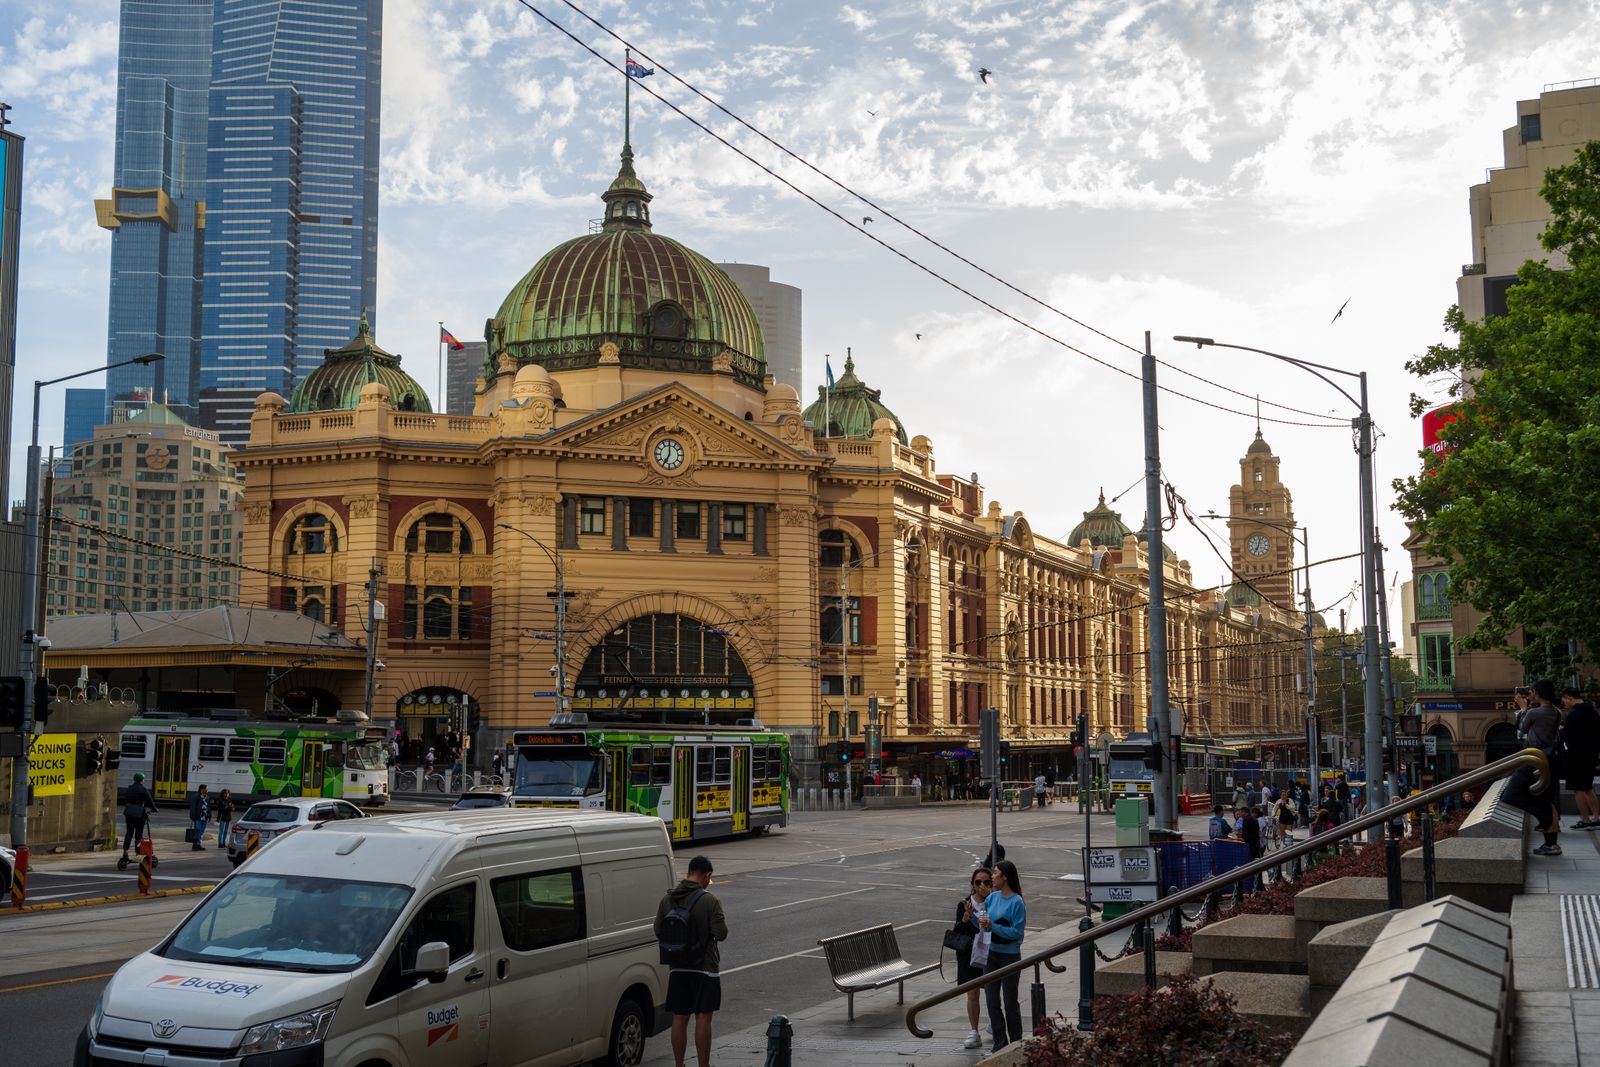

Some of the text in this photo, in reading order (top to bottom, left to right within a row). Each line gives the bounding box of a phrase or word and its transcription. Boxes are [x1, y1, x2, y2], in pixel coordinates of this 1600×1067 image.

[184, 426, 219, 441] Langham
[604, 677, 729, 685] FLINDS STREET STATION
[1495, 701, 1516, 710] PR
[571, 735, 579, 743] 75
[30, 743, 71, 754] ARNING
[29, 759, 65, 770] RUCKS
[29, 775, 65, 785] XITING
[1091, 855, 1114, 864] MC
[1125, 858, 1149, 866] MC
[1109, 888, 1132, 896] MC
[180, 976, 263, 998] Budget
[427, 1005, 459, 1025] Budget
